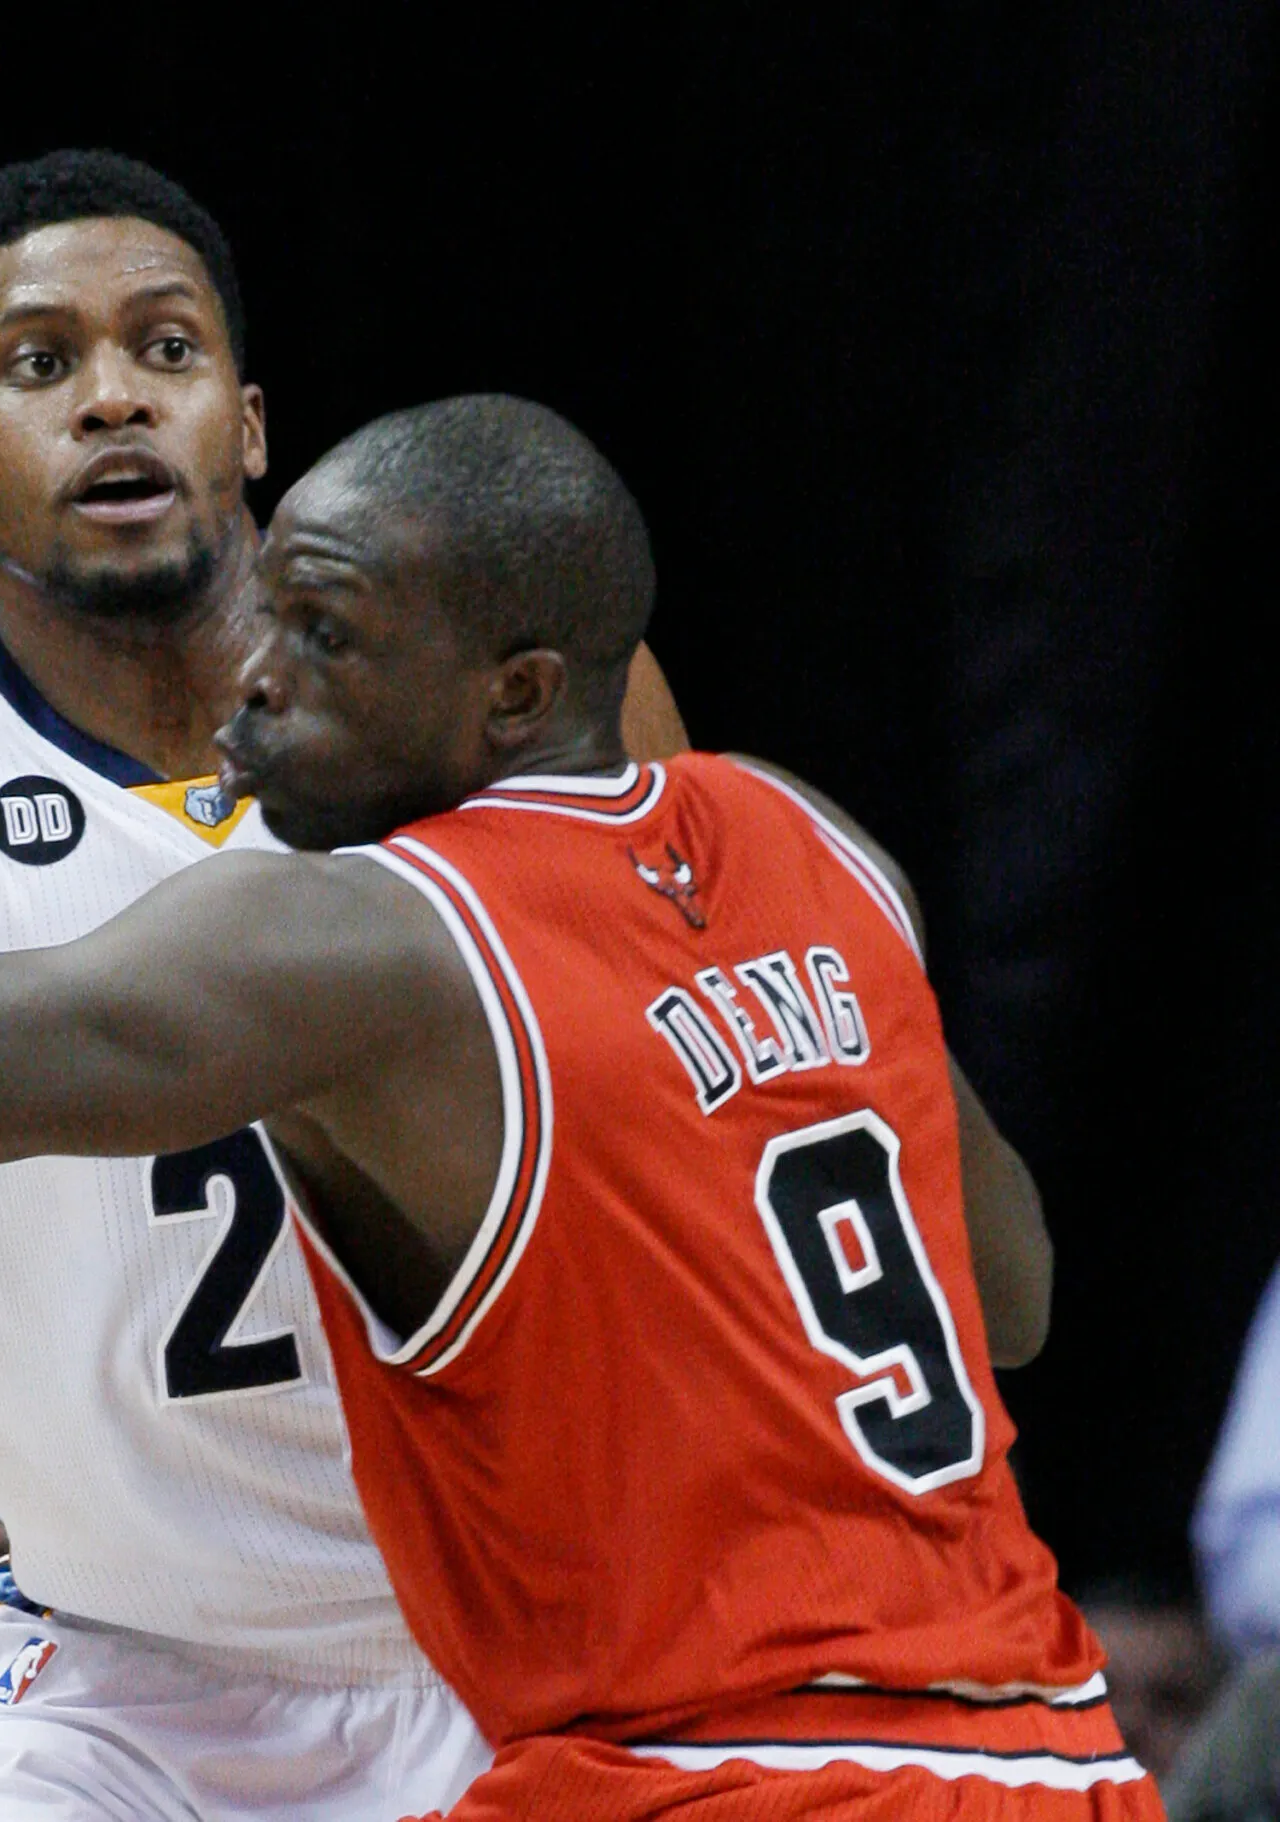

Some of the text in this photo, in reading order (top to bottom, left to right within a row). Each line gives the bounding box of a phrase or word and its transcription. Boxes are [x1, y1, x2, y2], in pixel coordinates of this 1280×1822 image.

[0, 793, 72, 845] DD
[645, 945, 871, 1116] DENG
[148, 1119, 308, 1406] 2
[754, 1108, 985, 1496] 9
